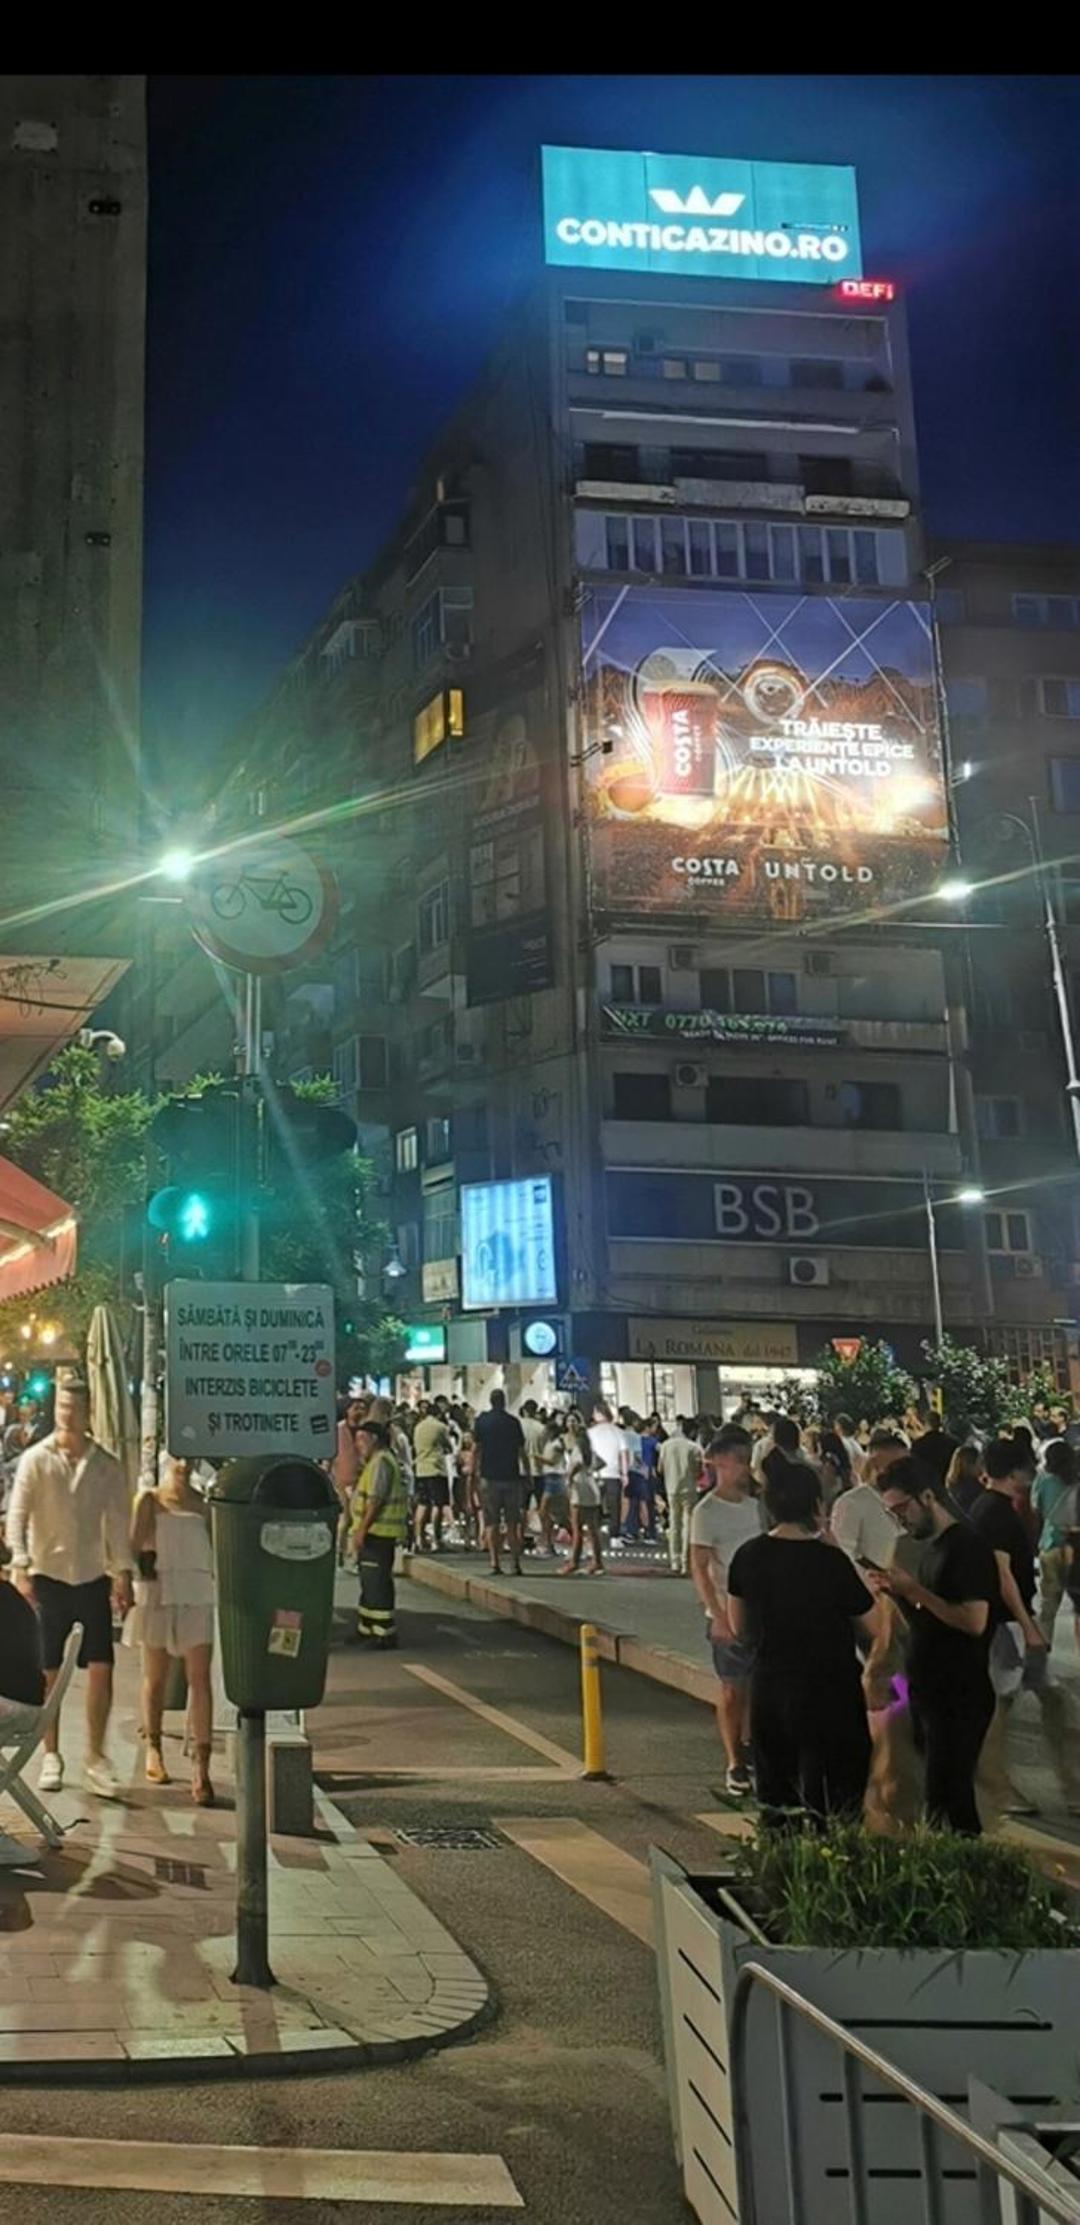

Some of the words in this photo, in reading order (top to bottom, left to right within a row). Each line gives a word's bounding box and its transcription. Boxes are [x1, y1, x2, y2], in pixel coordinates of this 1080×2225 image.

[556, 218, 848, 262] CONTICAZINO.RO
[779, 717, 883, 741] TRĂIEȘTE
[671, 709, 692, 777] COSTA
[862, 743, 915, 759] EPICE
[805, 757, 891, 777] UNTOLD
[672, 857, 739, 876] COSTA
[765, 860, 874, 882] UNTOLD
[714, 1184, 819, 1236] BSB
[260, 1306, 325, 1329] DUMINICĂ
[179, 1338, 220, 1362] ÎNTRE
[223, 1343, 269, 1363] ORELE
[665, 1339, 736, 1357] ROMANA
[185, 1378, 246, 1396] INTERZIS
[249, 1379, 319, 1397] BICICLETE
[223, 1413, 299, 1432] TROTINETE
